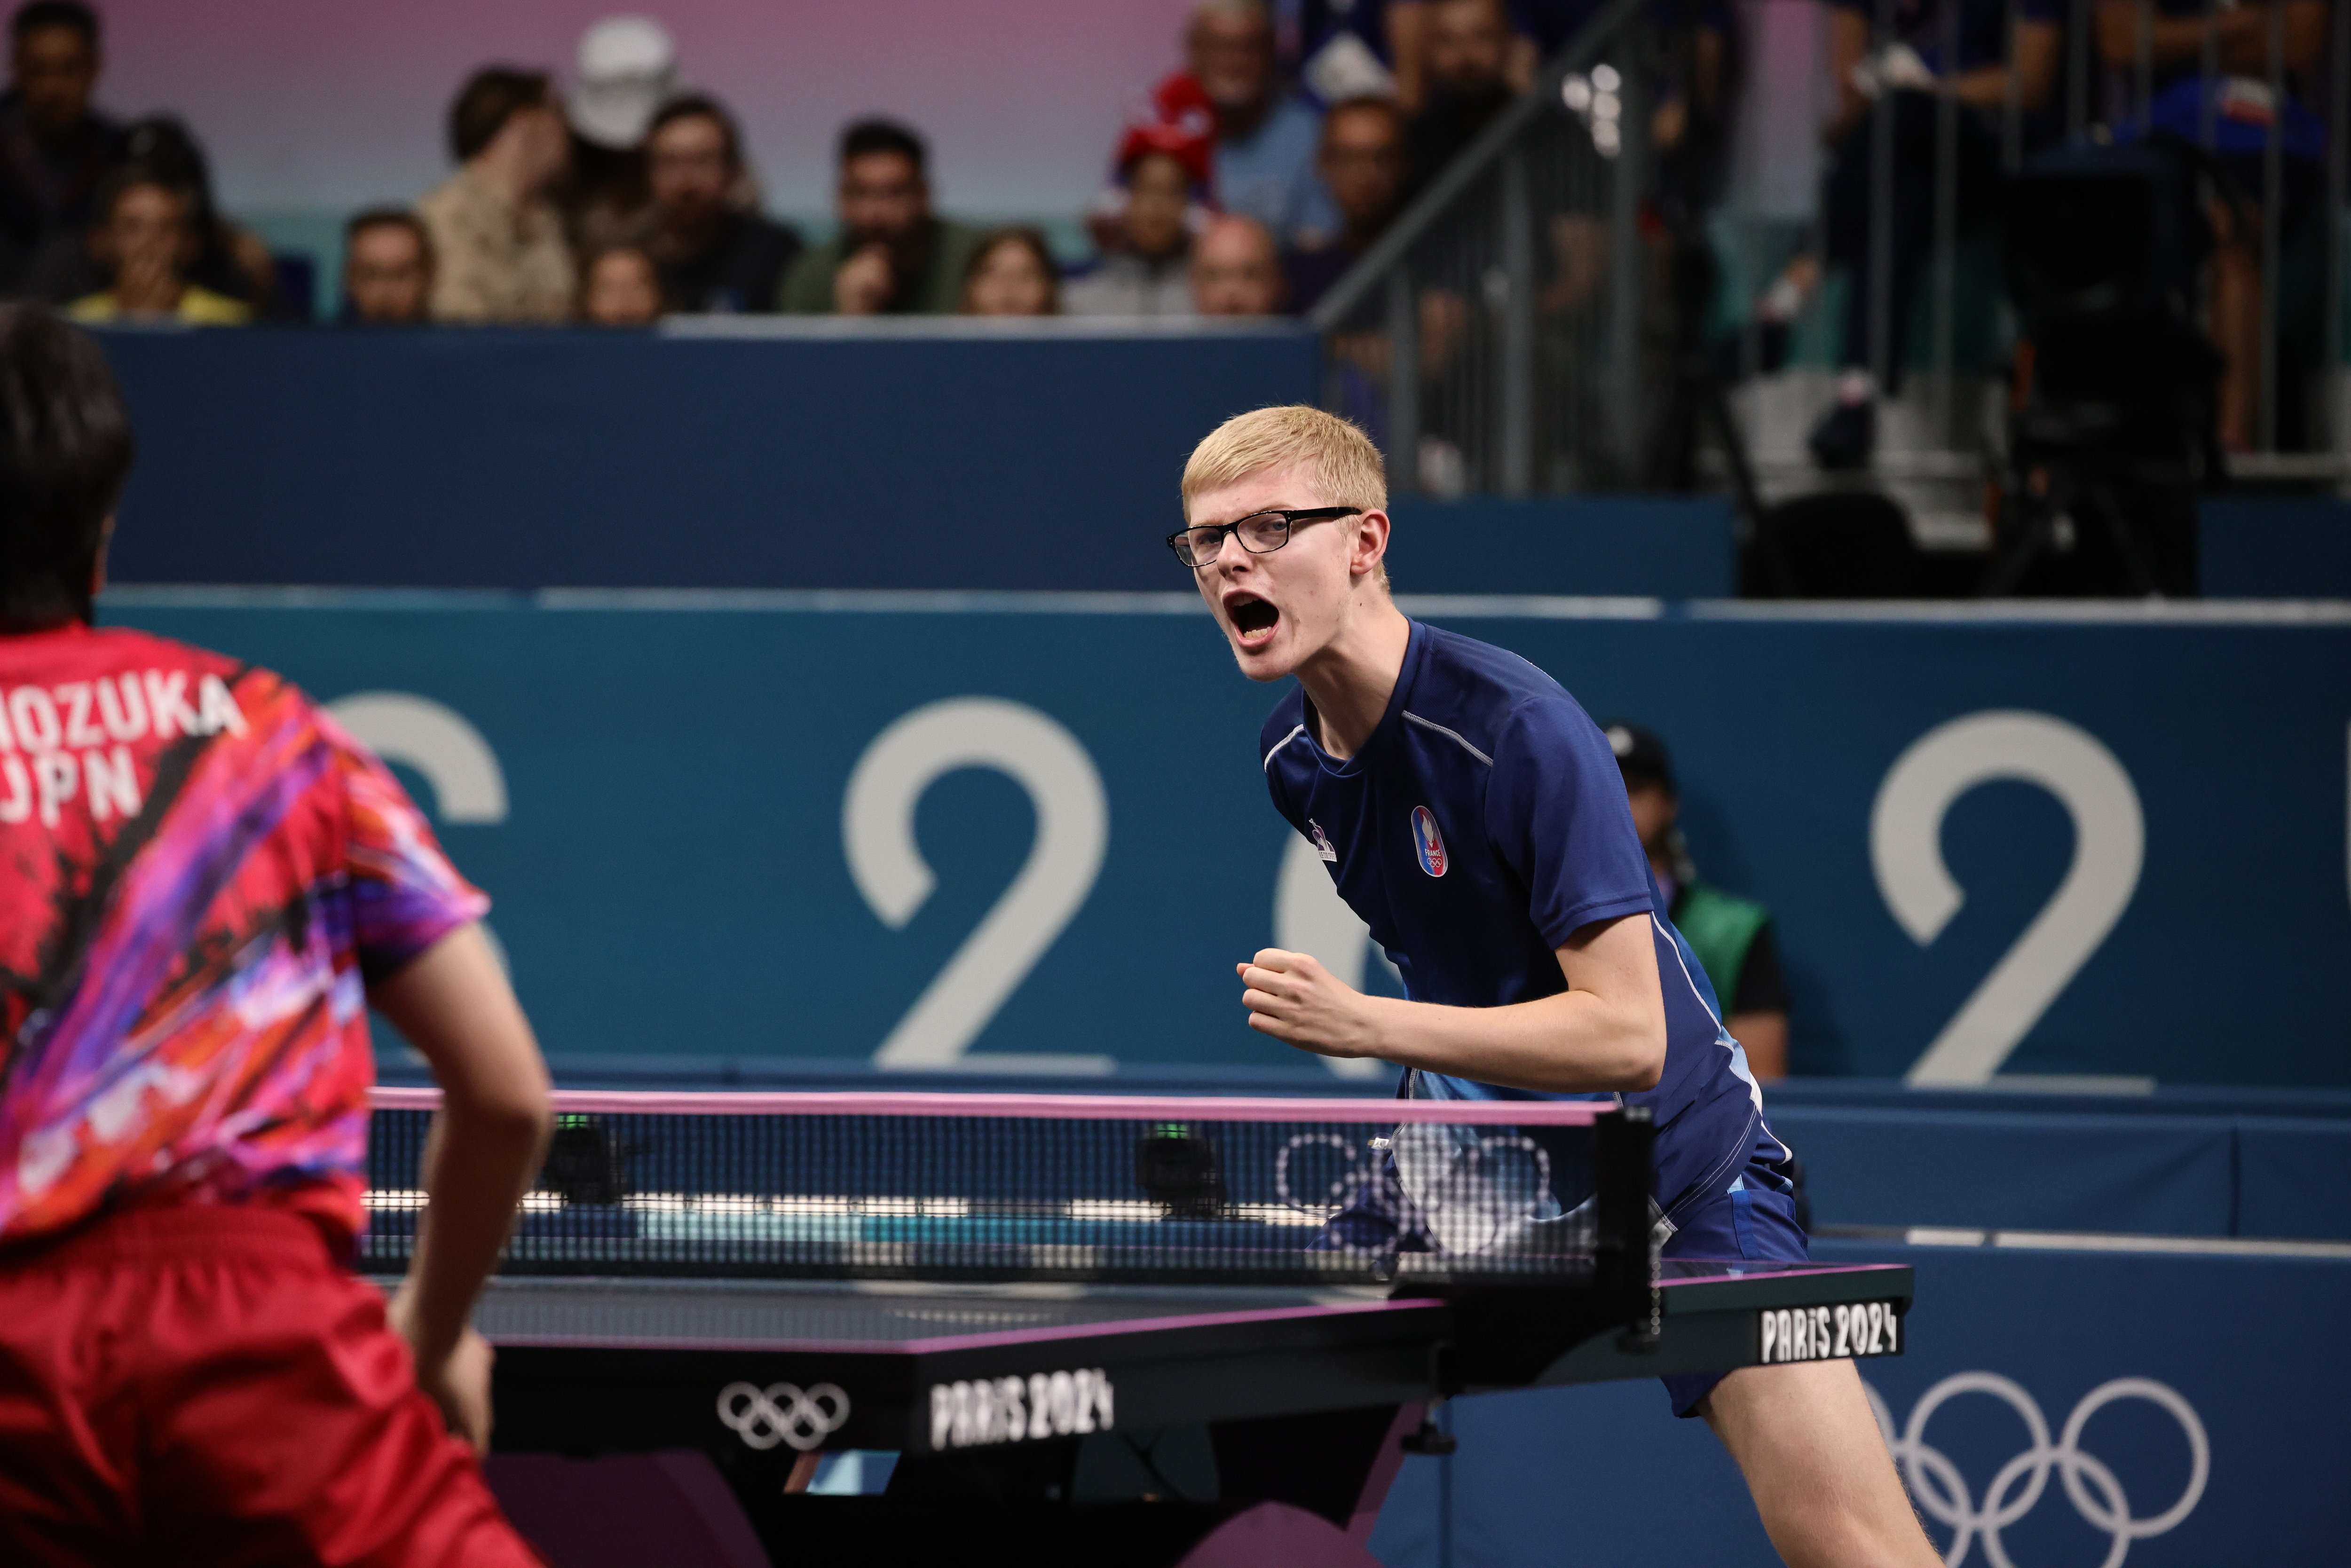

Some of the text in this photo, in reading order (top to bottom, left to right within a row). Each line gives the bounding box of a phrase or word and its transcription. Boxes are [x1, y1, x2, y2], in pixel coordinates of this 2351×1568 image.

[0, 671, 248, 754] OZUKA
[0, 746, 142, 828] JPN
[1425, 848, 1441, 857] FRANCE
[1835, 1302, 1897, 1356] 2024
[1028, 1368, 1114, 1439] 2024
